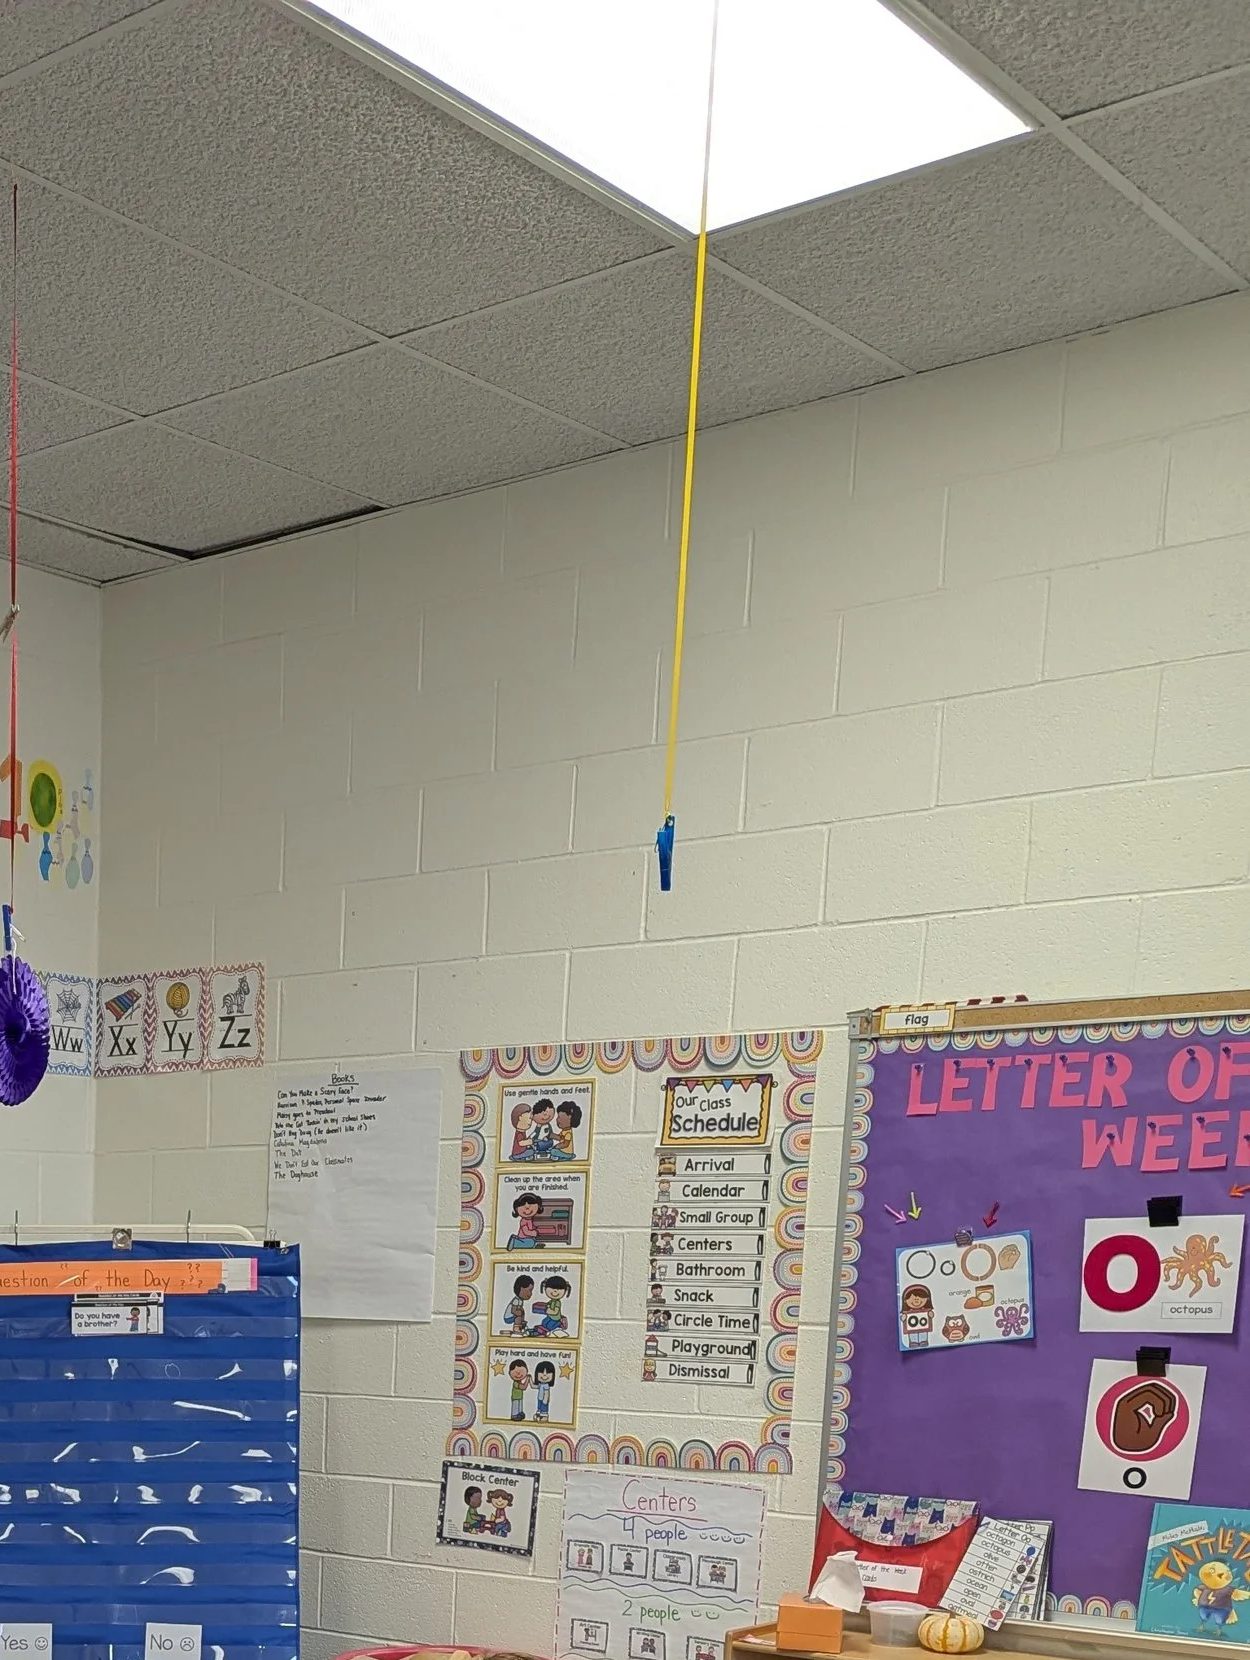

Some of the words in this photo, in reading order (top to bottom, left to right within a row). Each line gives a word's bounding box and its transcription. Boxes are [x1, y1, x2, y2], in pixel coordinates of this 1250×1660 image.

[904, 1012, 929, 1028] flag
[51, 1027, 83, 1052] Ww
[163, 1020, 193, 1058] Yy
[220, 1017, 252, 1049] Zz
[109, 1026, 138, 1056] Xx
[331, 1073, 355, 1084] Books
[907, 1051, 1132, 1117] LETTER
[1167, 1041, 1250, 1103] OF
[320, 1087, 336, 1097] Scary
[504, 1089, 517, 1097] Use
[518, 1088, 538, 1098] gentle
[539, 1087, 560, 1096] hands
[560, 1087, 573, 1095] and
[676, 1096, 699, 1108] Our
[699, 1097, 732, 1112] Class
[672, 1112, 759, 1133] Schedule
[275, 1149, 287, 1158] The
[684, 1157, 735, 1172] Arrival
[273, 1171, 286, 1180] The
[290, 1170, 319, 1182] Doghouse
[504, 1176, 522, 1184] Clean
[532, 1175, 544, 1183] the
[514, 1184, 527, 1193] you
[682, 1183, 745, 1198] Calendar
[679, 1210, 712, 1222] Small
[715, 1210, 754, 1226] Group
[678, 1237, 733, 1251] Centers
[544, 1265, 569, 1274] helpful.
[676, 1262, 746, 1277] Bathroom
[1084, 1234, 1161, 1312] O
[73, 1269, 88, 1287] of
[106, 1269, 130, 1287] the
[144, 1269, 171, 1290] Day
[673, 1288, 714, 1303] Snack
[948, 1289, 972, 1298] orange
[1000, 1297, 1025, 1306] octopus
[87, 1313, 100, 1321] you
[1169, 1304, 1214, 1316] octopus
[84, 1320, 118, 1328] brother?
[674, 1313, 713, 1328] Circle
[717, 1314, 751, 1329] Time
[907, 1315, 928, 1328] Oo
[494, 1348, 509, 1357] Play
[510, 1349, 526, 1357] hard
[671, 1338, 751, 1357] Playground
[668, 1363, 730, 1379] Dismissal
[461, 1471, 486, 1483] Block
[488, 1474, 520, 1487] Center
[1122, 1466, 1148, 1489] O
[622, 1479, 697, 1512] Centers
[623, 1516, 635, 1540] 4
[645, 1523, 688, 1546] people
[993, 1522, 1020, 1537] Letter
[985, 1530, 1016, 1547] octagon
[981, 1540, 1011, 1557] octopus
[983, 1551, 999, 1562] olive
[975, 1559, 998, 1572] otter
[968, 1567, 995, 1583] ostrich
[966, 1578, 988, 1591] ocean
[963, 1587, 982, 1600] open
[960, 1597, 975, 1608] oval
[621, 1599, 633, 1617] 2
[640, 1604, 681, 1626] people
[947, 1602, 979, 1620] oatmeal
[0, 1634, 29, 1651] Yes
[150, 1633, 174, 1651] No
